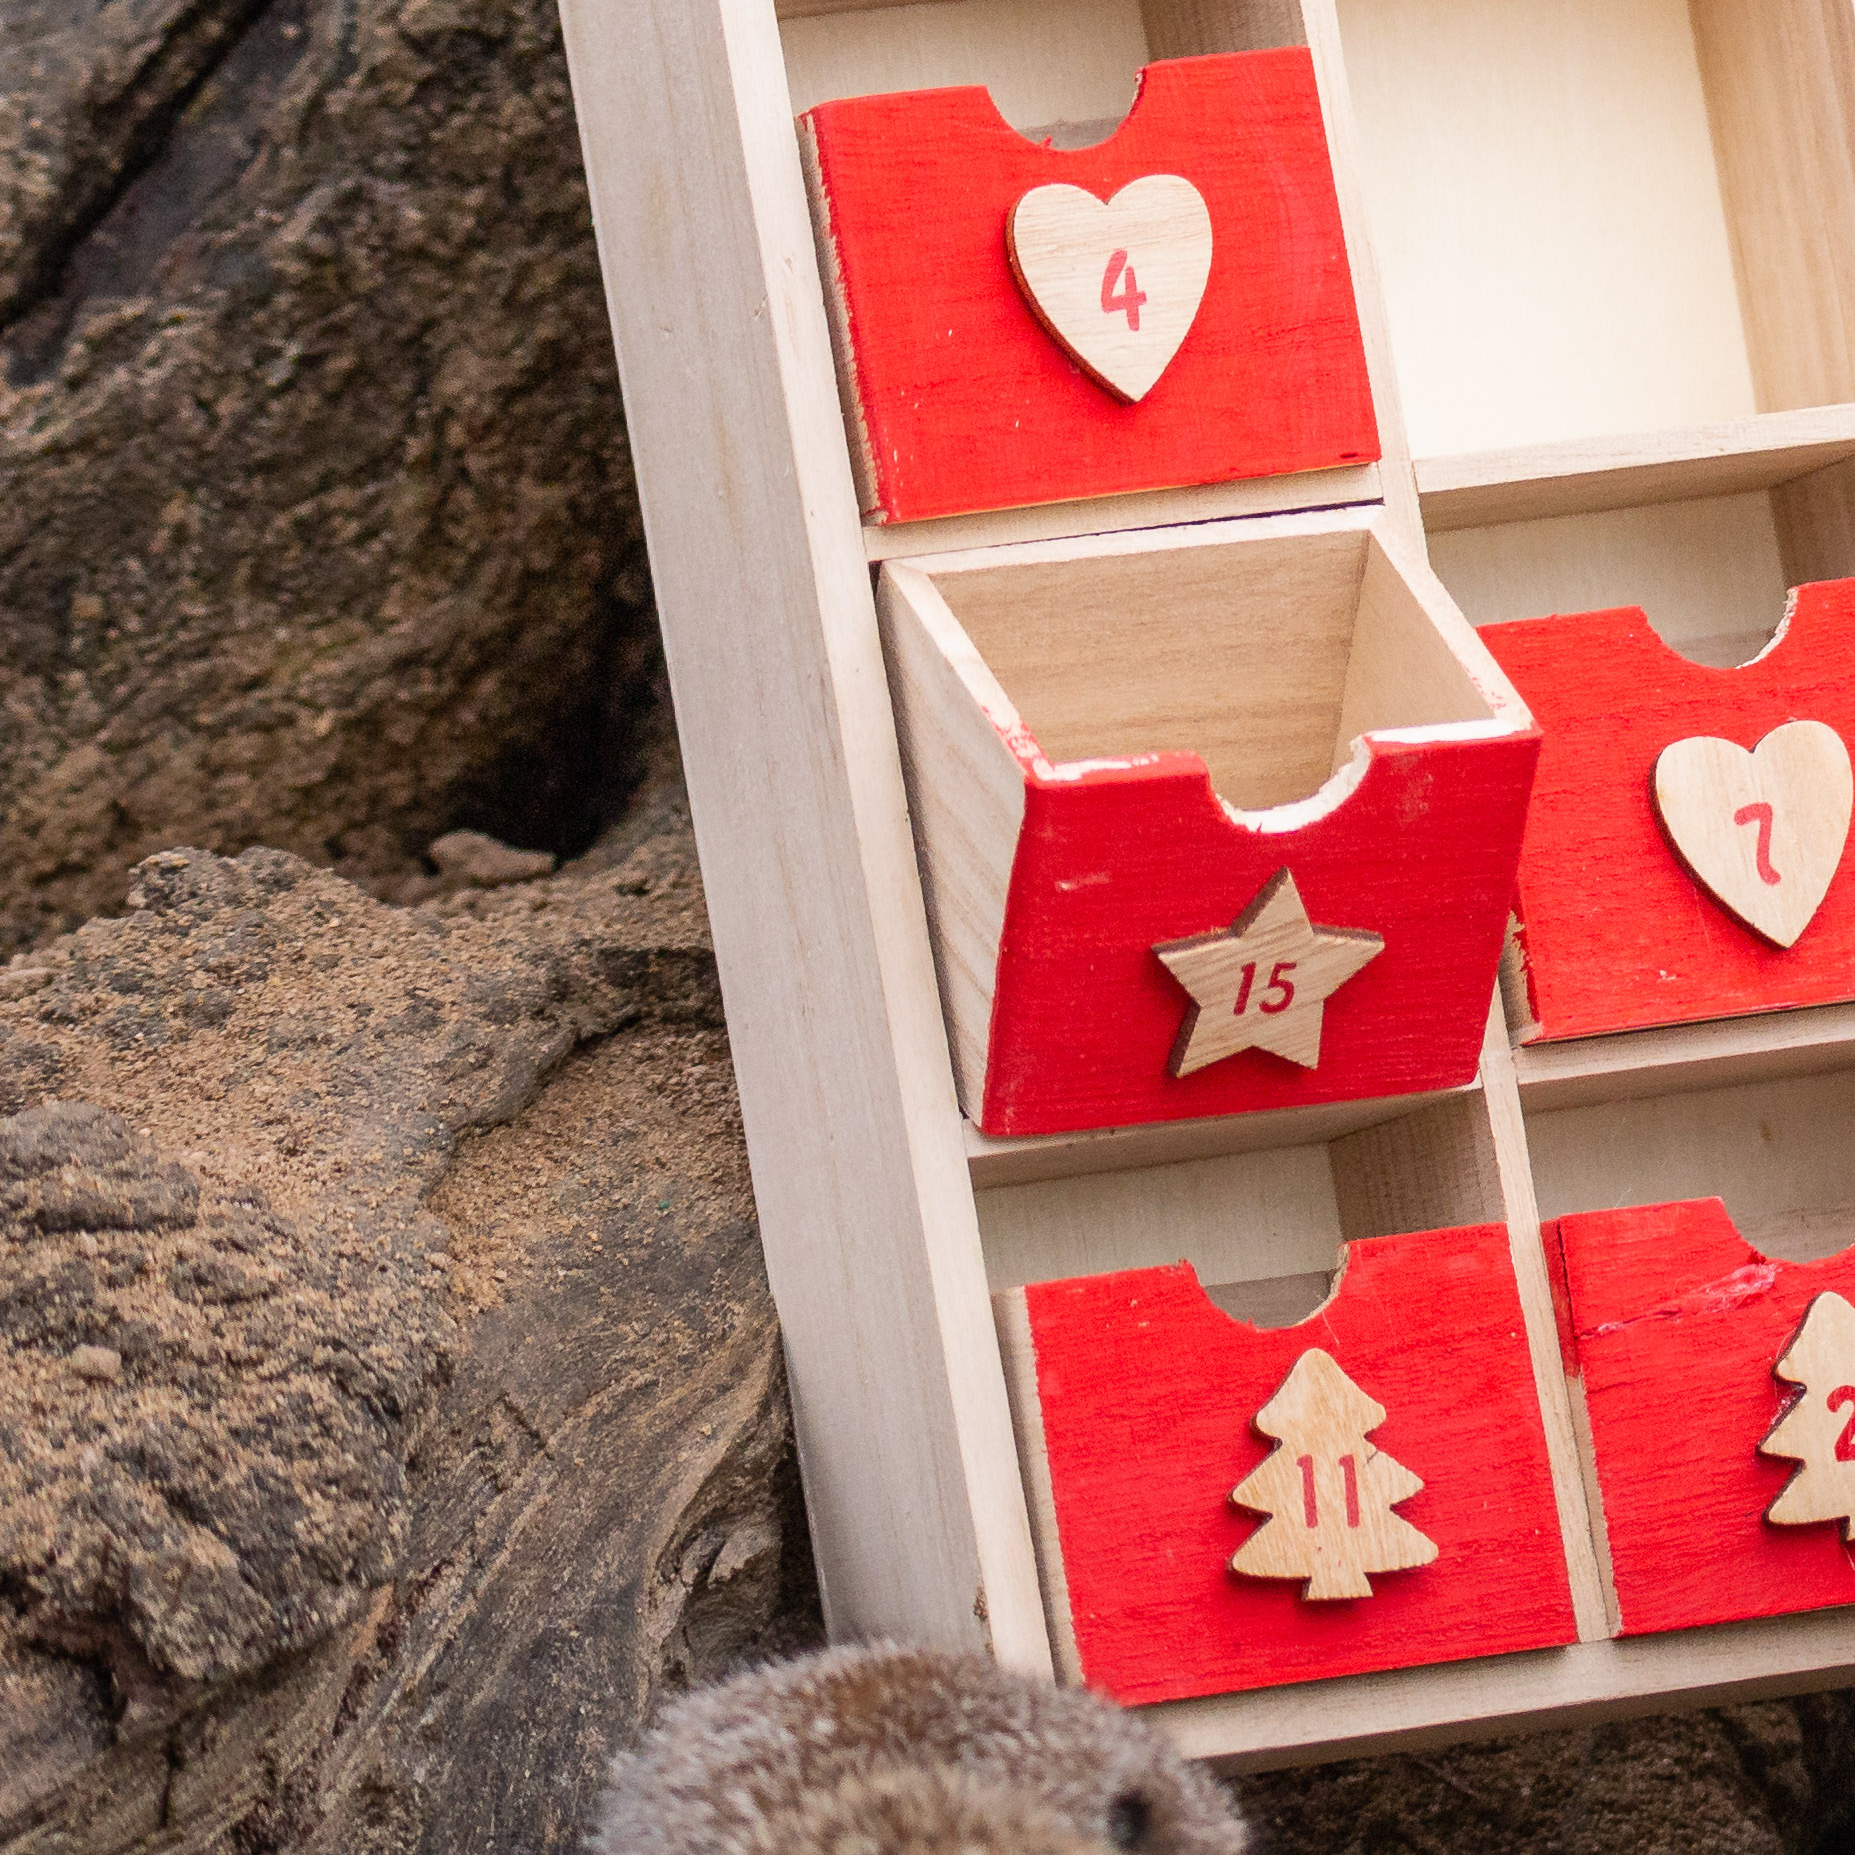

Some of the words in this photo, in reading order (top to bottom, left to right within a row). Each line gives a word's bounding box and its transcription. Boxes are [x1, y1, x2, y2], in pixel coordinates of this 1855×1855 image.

[1100, 249, 1147, 332] 4
[1733, 802, 1781, 886] 7
[1232, 961, 1297, 1017] 15
[1296, 1453, 1361, 1529] 11
